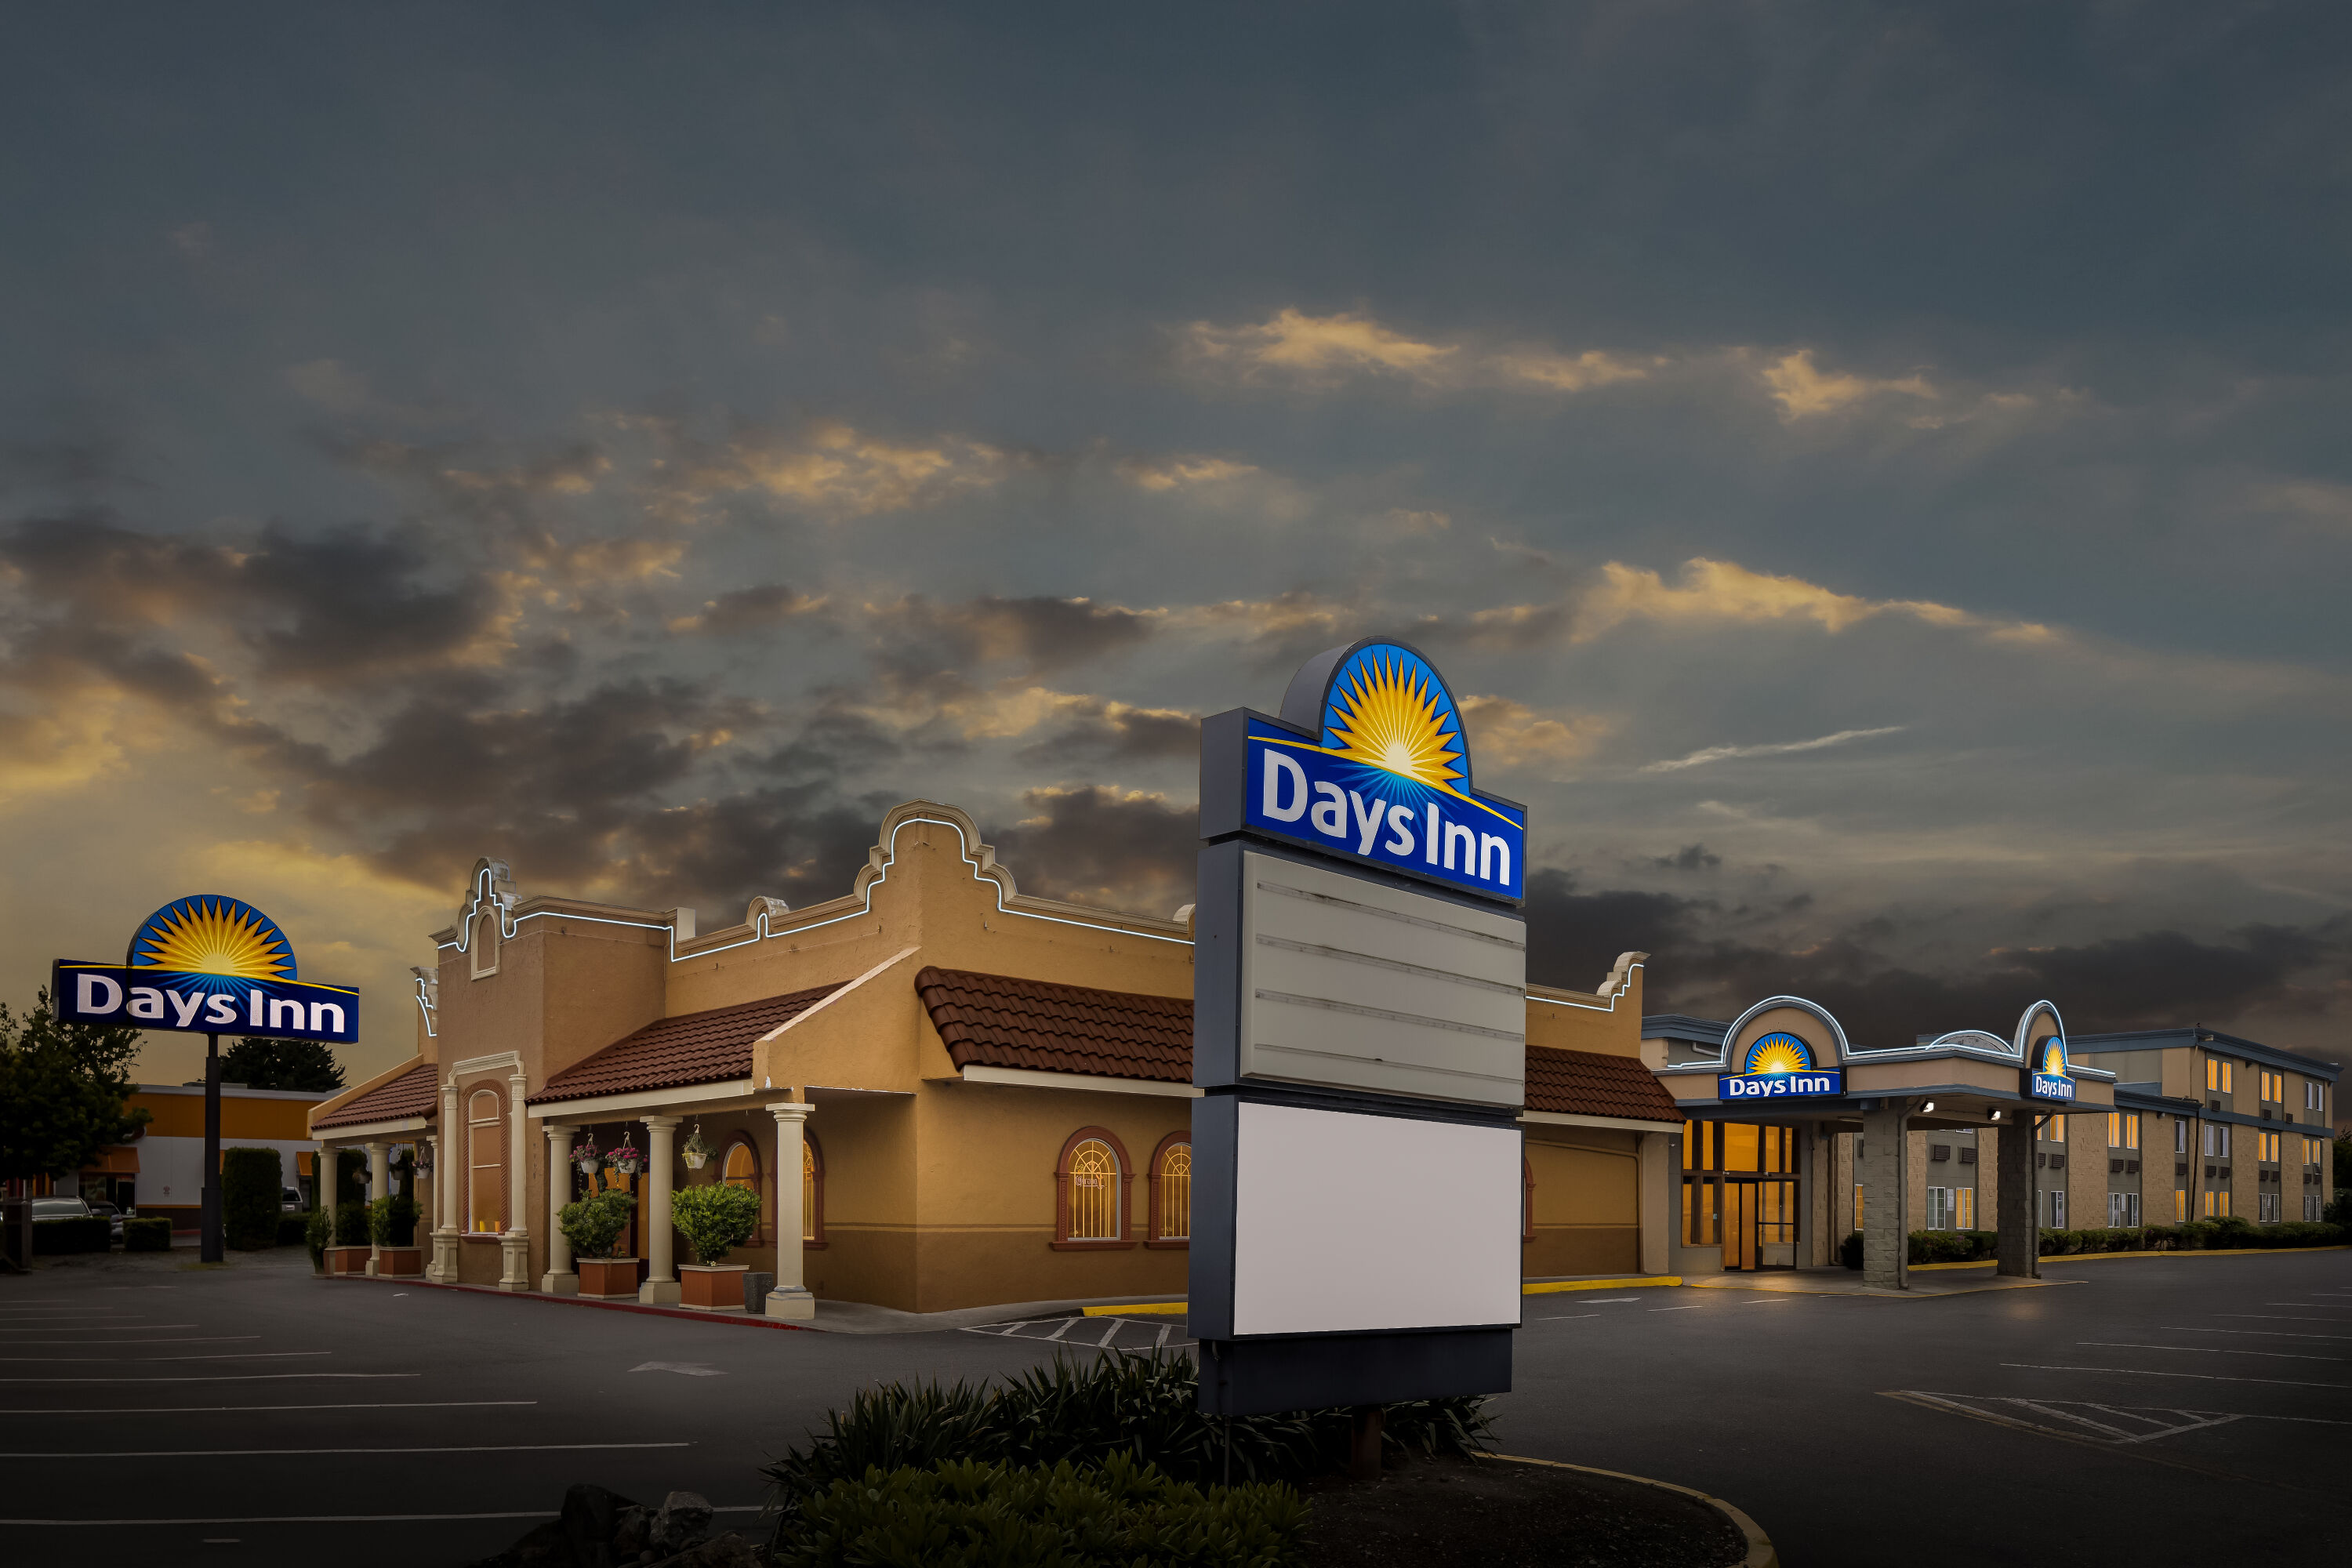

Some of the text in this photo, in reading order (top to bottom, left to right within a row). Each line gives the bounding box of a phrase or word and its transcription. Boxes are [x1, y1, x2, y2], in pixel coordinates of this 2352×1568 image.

[1262, 748, 1511, 886] Days Inn
[77, 973, 345, 1033] Days Inn
[1730, 1076, 1830, 1096] Days Inn
[2035, 1076, 2072, 1097] Days Inn
